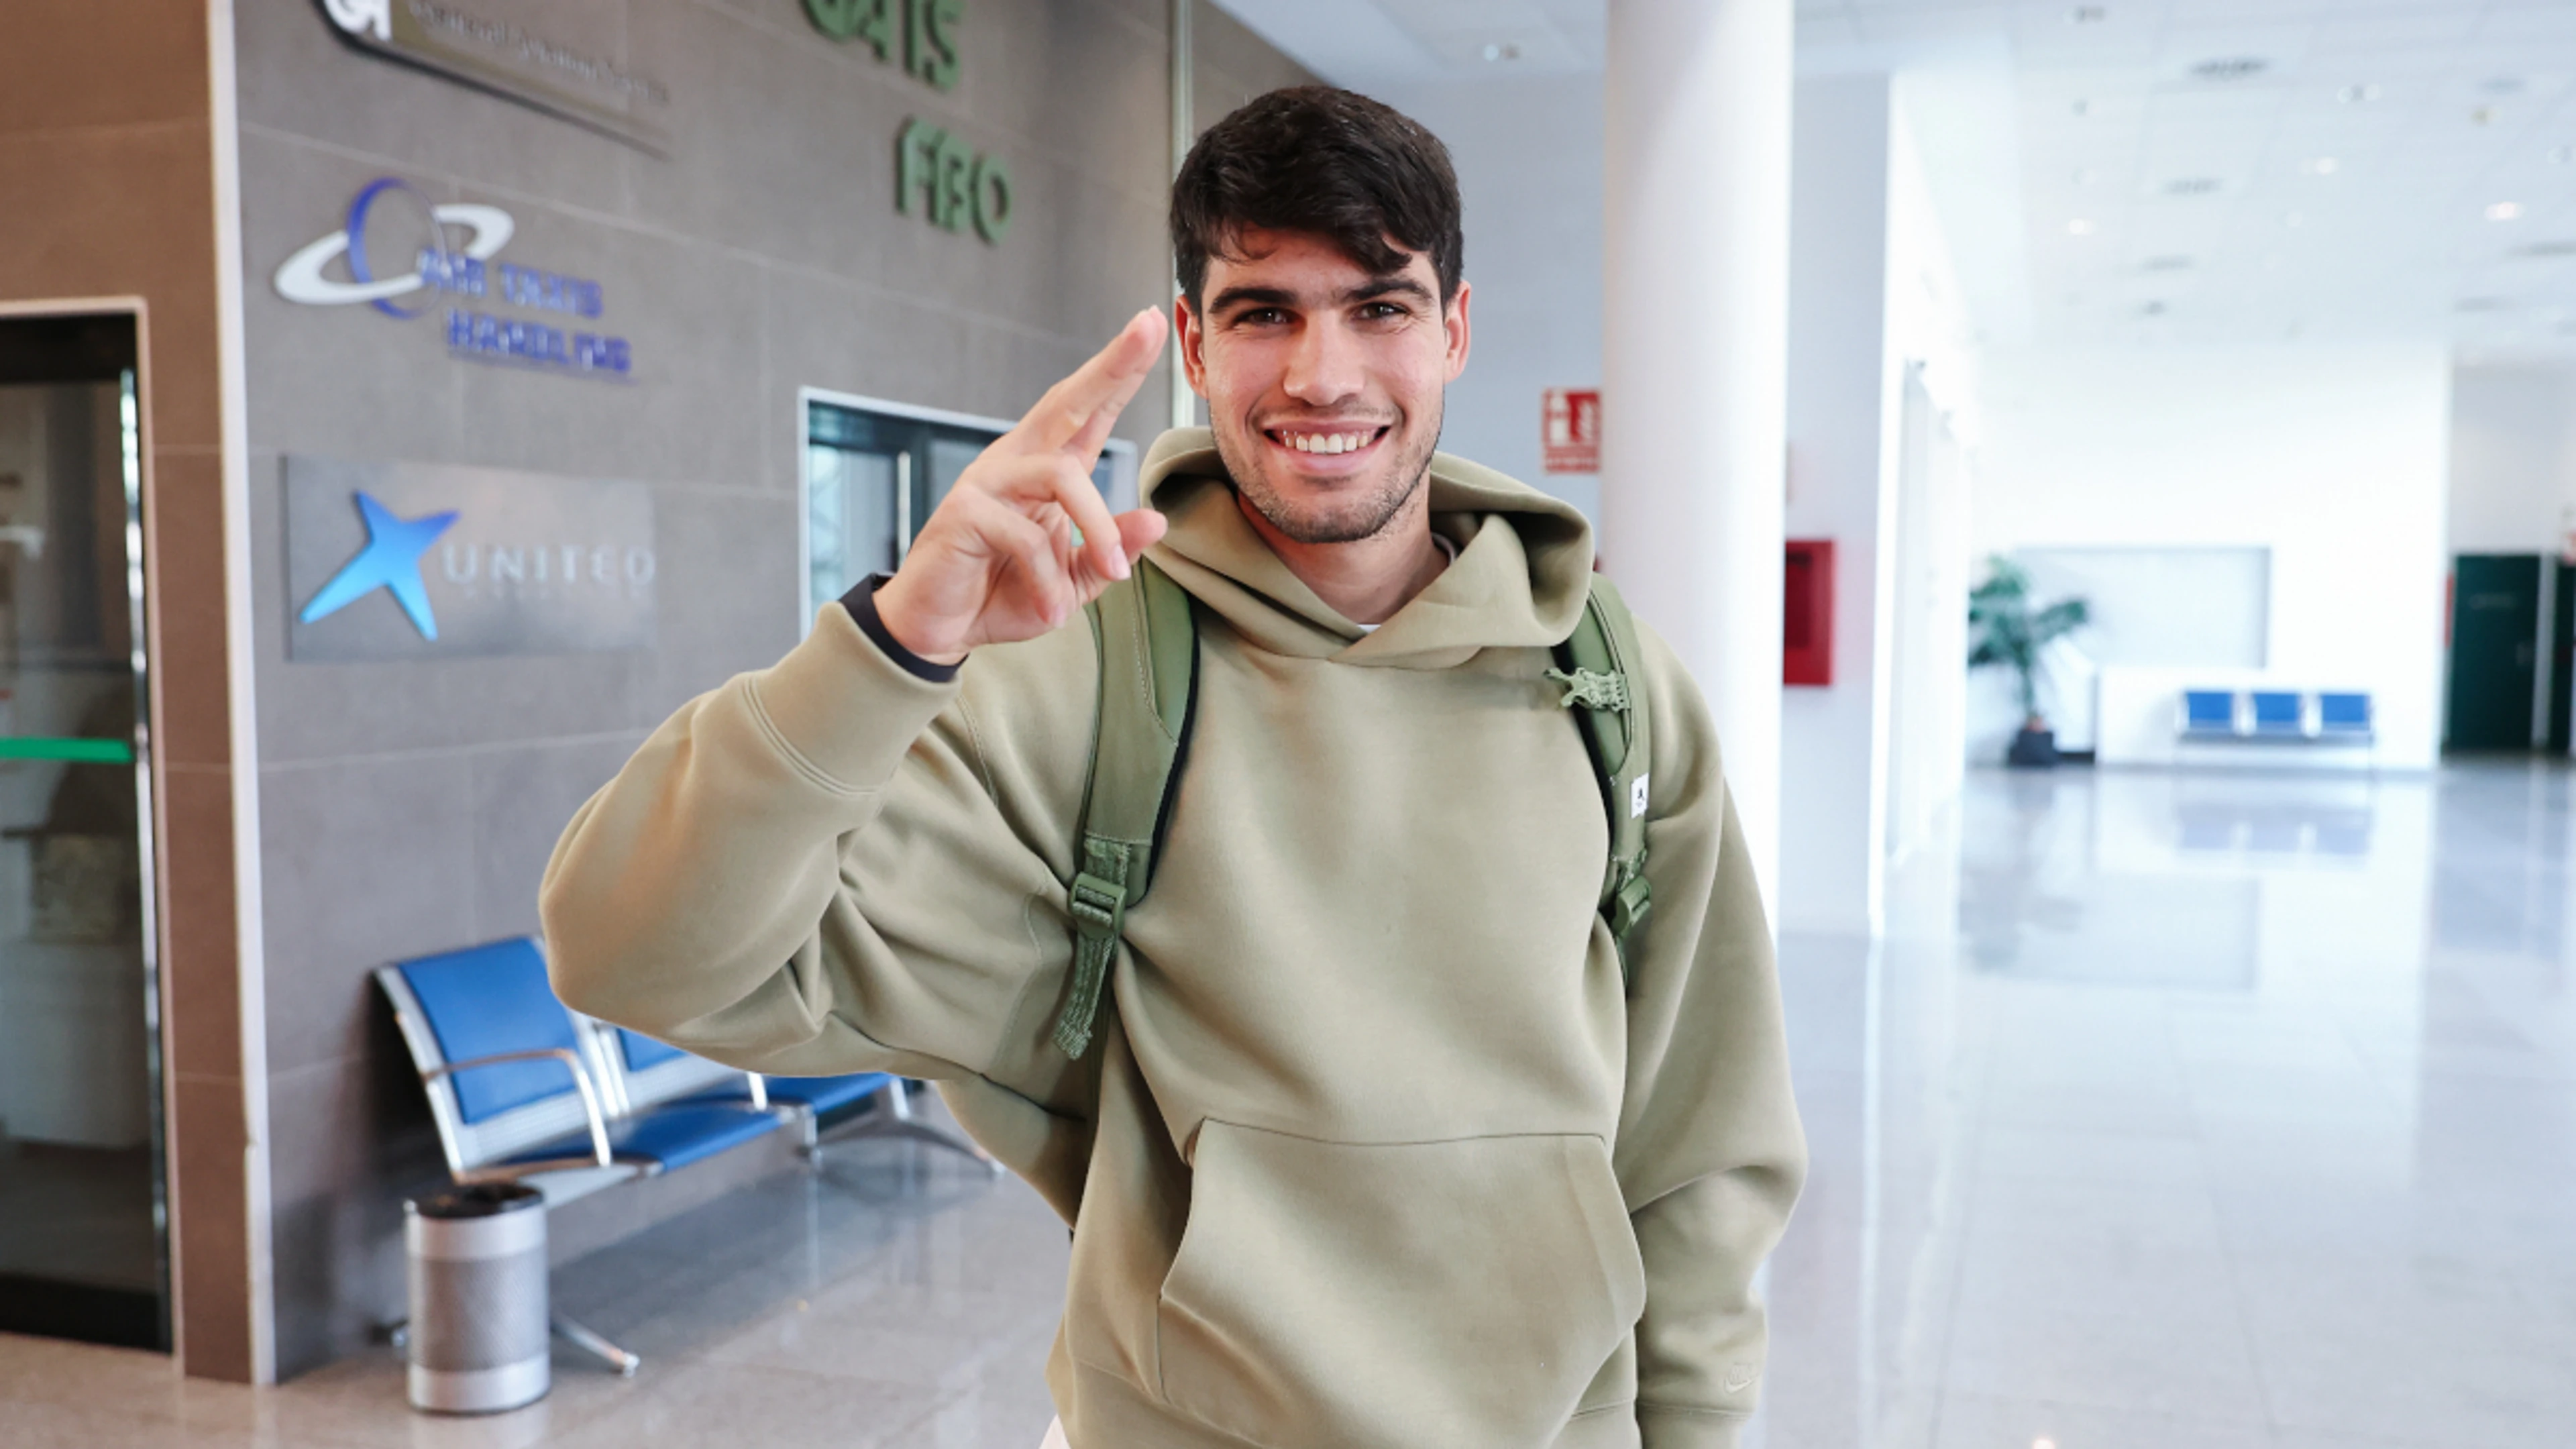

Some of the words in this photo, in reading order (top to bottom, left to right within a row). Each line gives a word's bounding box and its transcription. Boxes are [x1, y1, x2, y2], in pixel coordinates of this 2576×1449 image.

[896, 115, 1012, 246] FBO
[444, 306, 632, 374] HANDLING
[443, 542, 657, 586] UNITED
